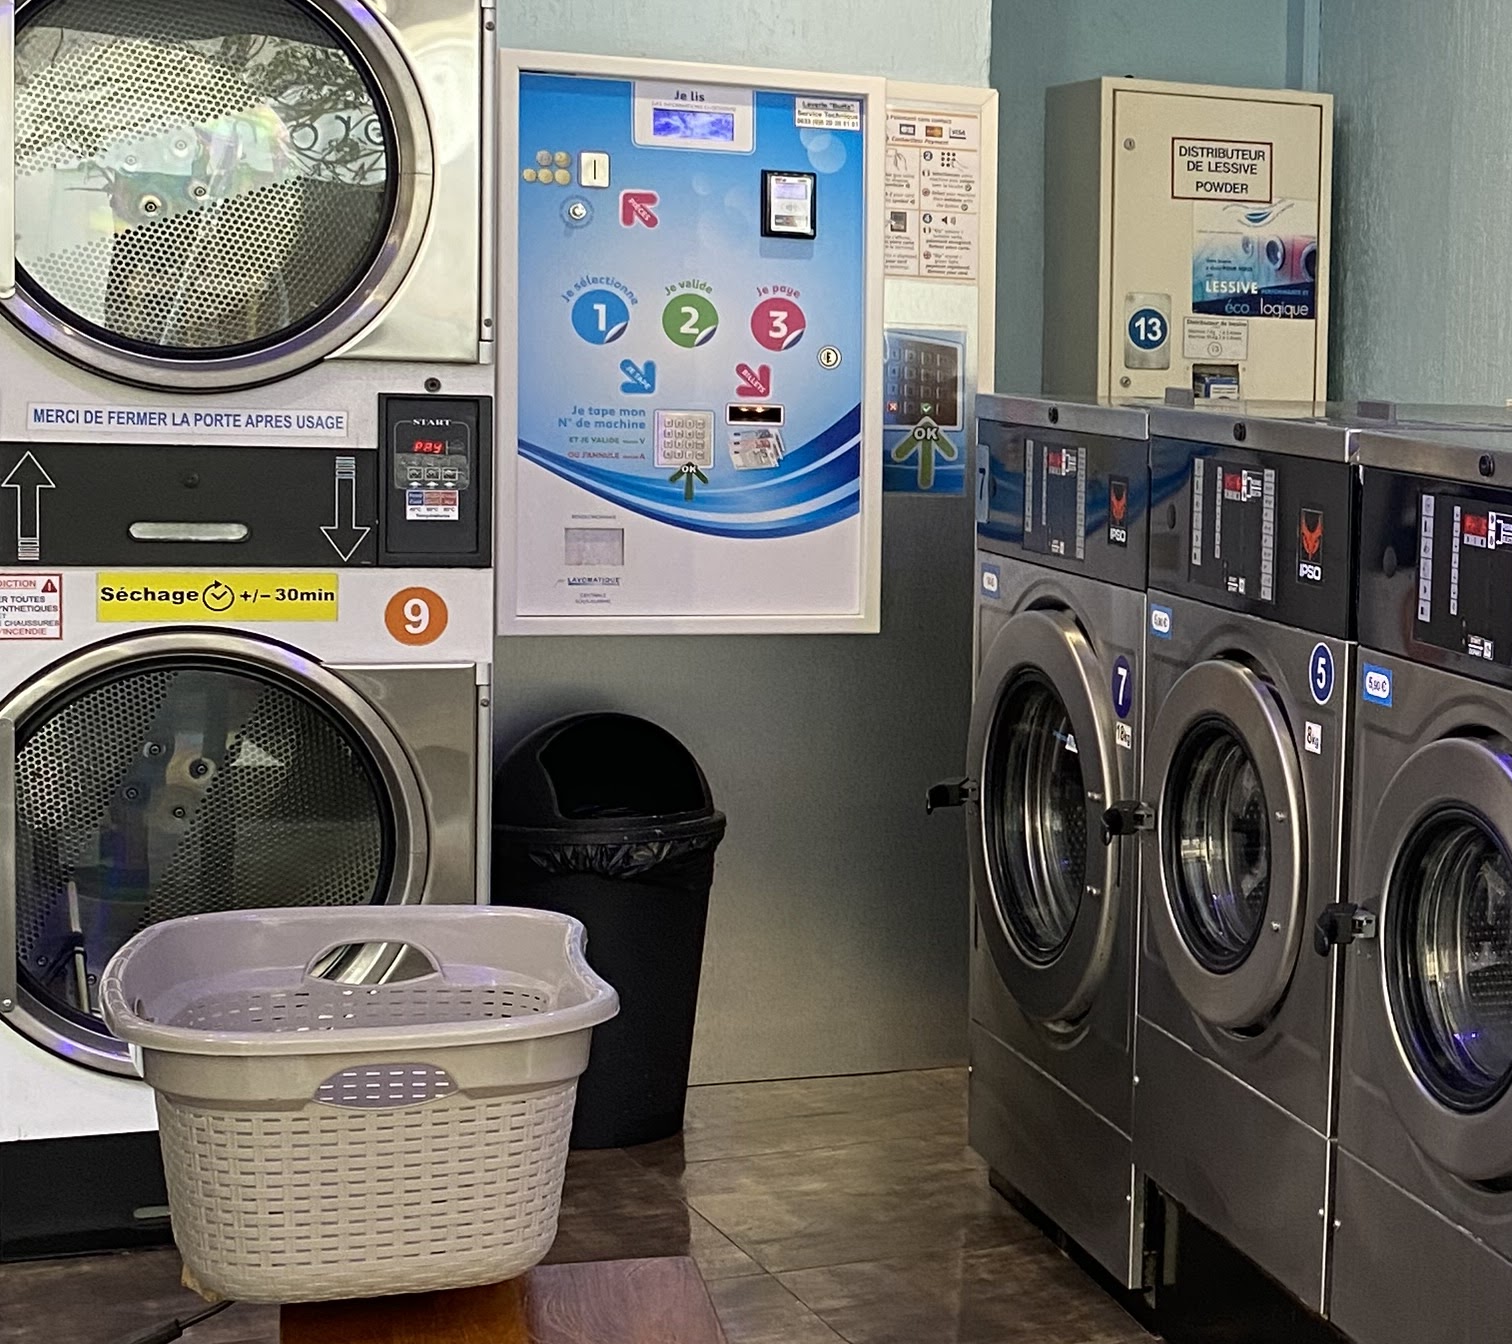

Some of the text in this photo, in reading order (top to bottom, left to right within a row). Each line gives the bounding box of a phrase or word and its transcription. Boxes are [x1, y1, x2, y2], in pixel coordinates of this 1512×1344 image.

[674, 90, 705, 102] Je lis
[1179, 146, 1265, 161] DISTRIBUTEUR
[1187, 160, 1257, 174] DE LESSIVE
[1196, 181, 1248, 194] POWDER
[561, 275, 638, 306] Je sélectionne
[664, 279, 712, 296] Je valide
[756, 285, 800, 299] Je paye
[1205, 281, 1258, 294] LESSIVE
[593, 304, 606, 331] 1
[1225, 298, 1308, 318] éco logique
[679, 307, 699, 334] 2
[769, 311, 788, 338] 3
[1134, 316, 1162, 341] 13
[741, 369, 766, 394] BILLETS
[34, 408, 343, 430] MERCI DE FERMER LA PORTE APRES USAGE
[558, 419, 646, 429] N° de machine
[914, 428, 938, 440] OK
[1110, 528, 1126, 543] IPSO
[1299, 563, 1321, 581] IPSO
[404, 598, 430, 634] 9
[1317, 657, 1326, 689] 5
[1117, 667, 1127, 706] 7
